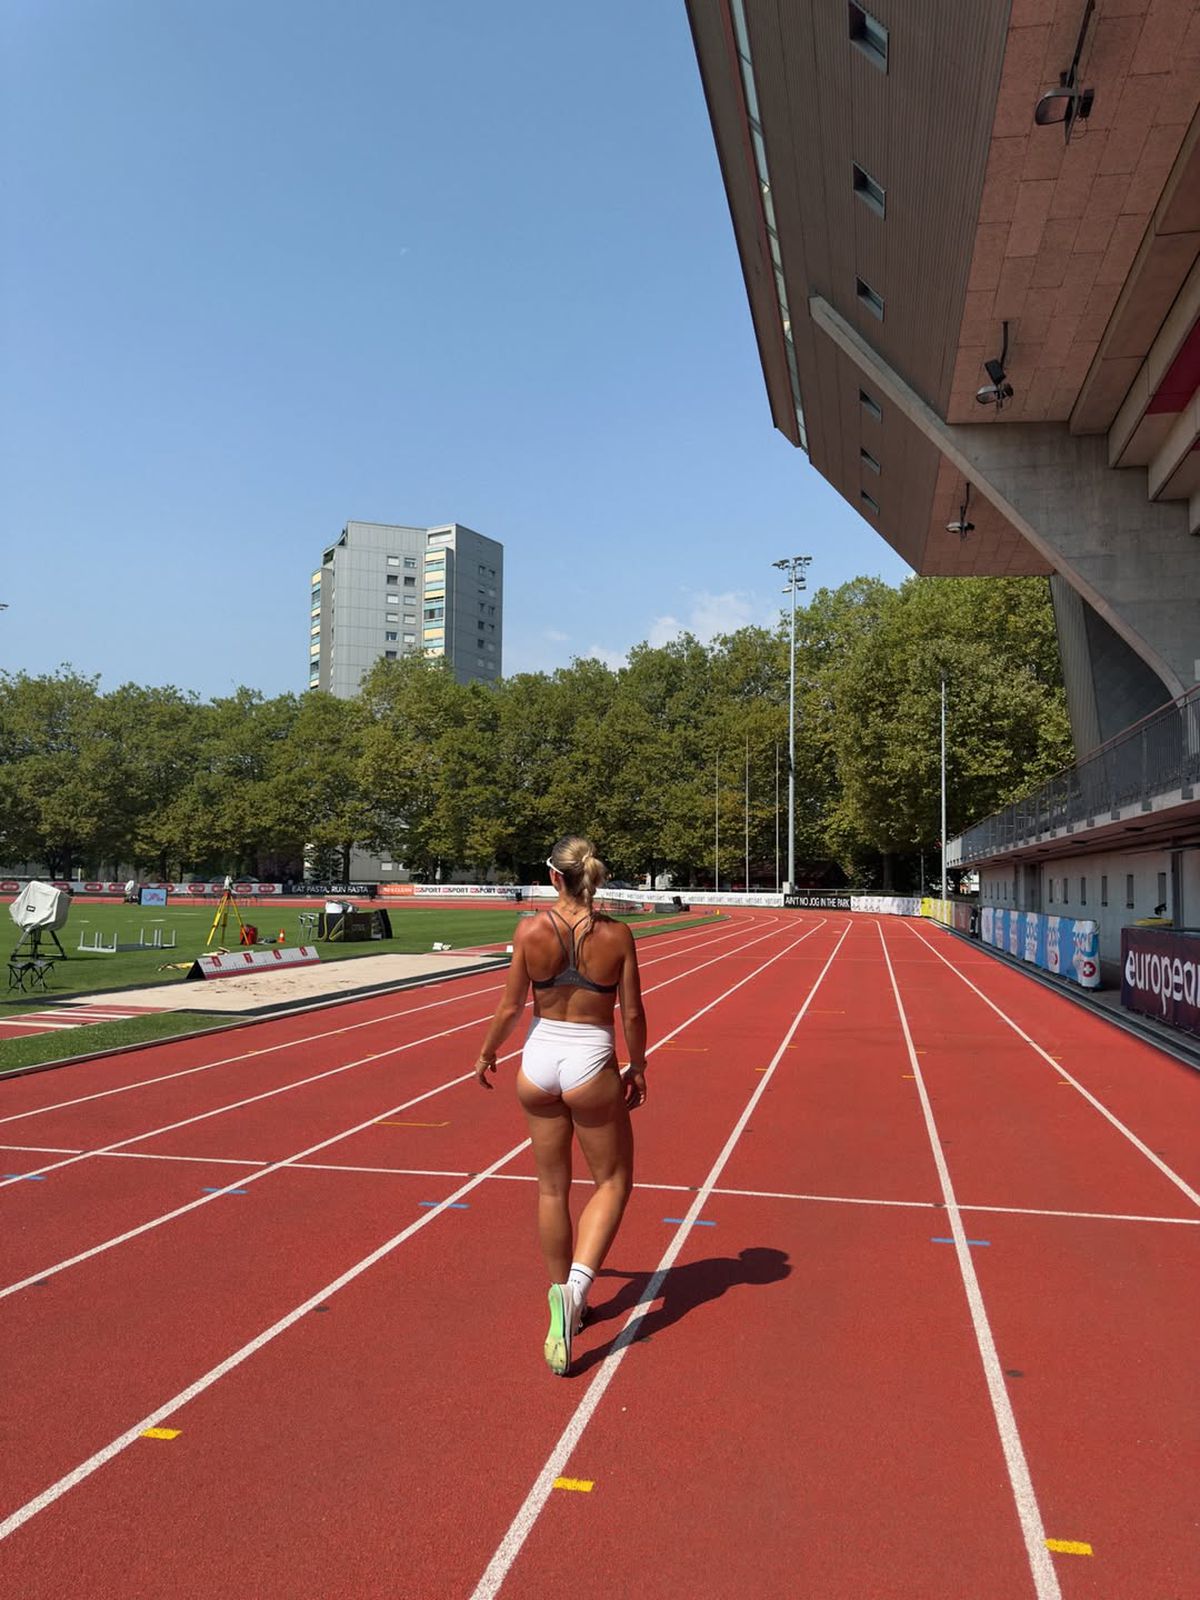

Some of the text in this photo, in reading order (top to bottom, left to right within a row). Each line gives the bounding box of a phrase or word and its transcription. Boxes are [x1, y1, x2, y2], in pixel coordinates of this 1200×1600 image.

[331, 885, 345, 893] RUN
[347, 885, 368, 893] FASTA
[800, 897, 808, 906] NO
[809, 897, 819, 907] JOG
[827, 898, 836, 907] THE
[837, 898, 850, 907] PARK
[1125, 950, 1200, 1016] europea
